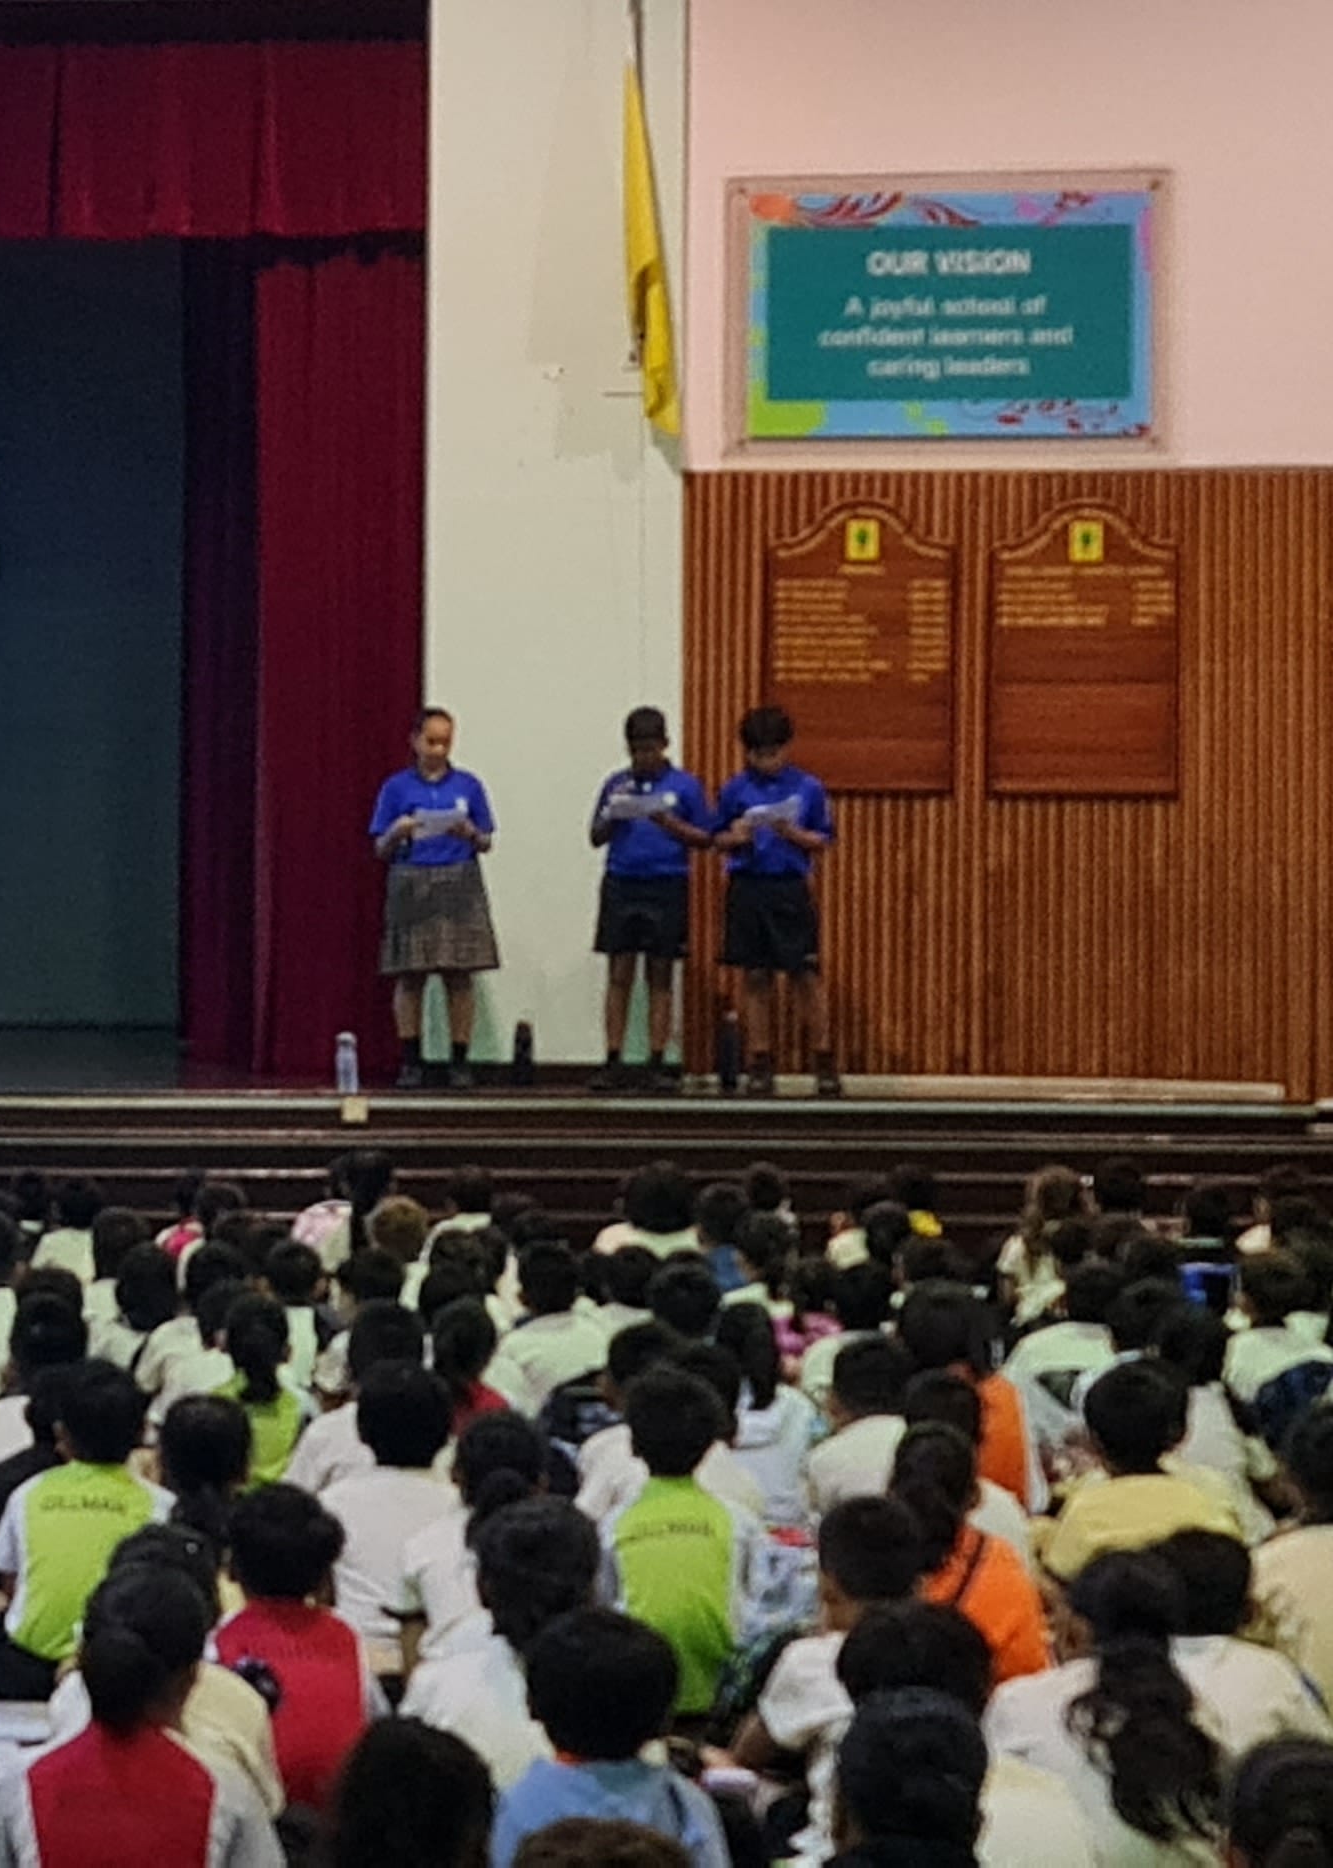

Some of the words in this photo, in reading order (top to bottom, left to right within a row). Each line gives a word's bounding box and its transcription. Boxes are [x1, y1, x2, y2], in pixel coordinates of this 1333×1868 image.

[866, 250, 929, 275] OUR
[934, 250, 1031, 274] VISION
[844, 296, 864, 316] A
[870, 296, 933, 319] joyful
[940, 296, 1016, 316] school
[1021, 296, 1047, 316] of
[818, 327, 925, 347] confident
[1029, 325, 1074, 345] and
[866, 357, 941, 380] caring
[944, 356, 1031, 376] leaders
